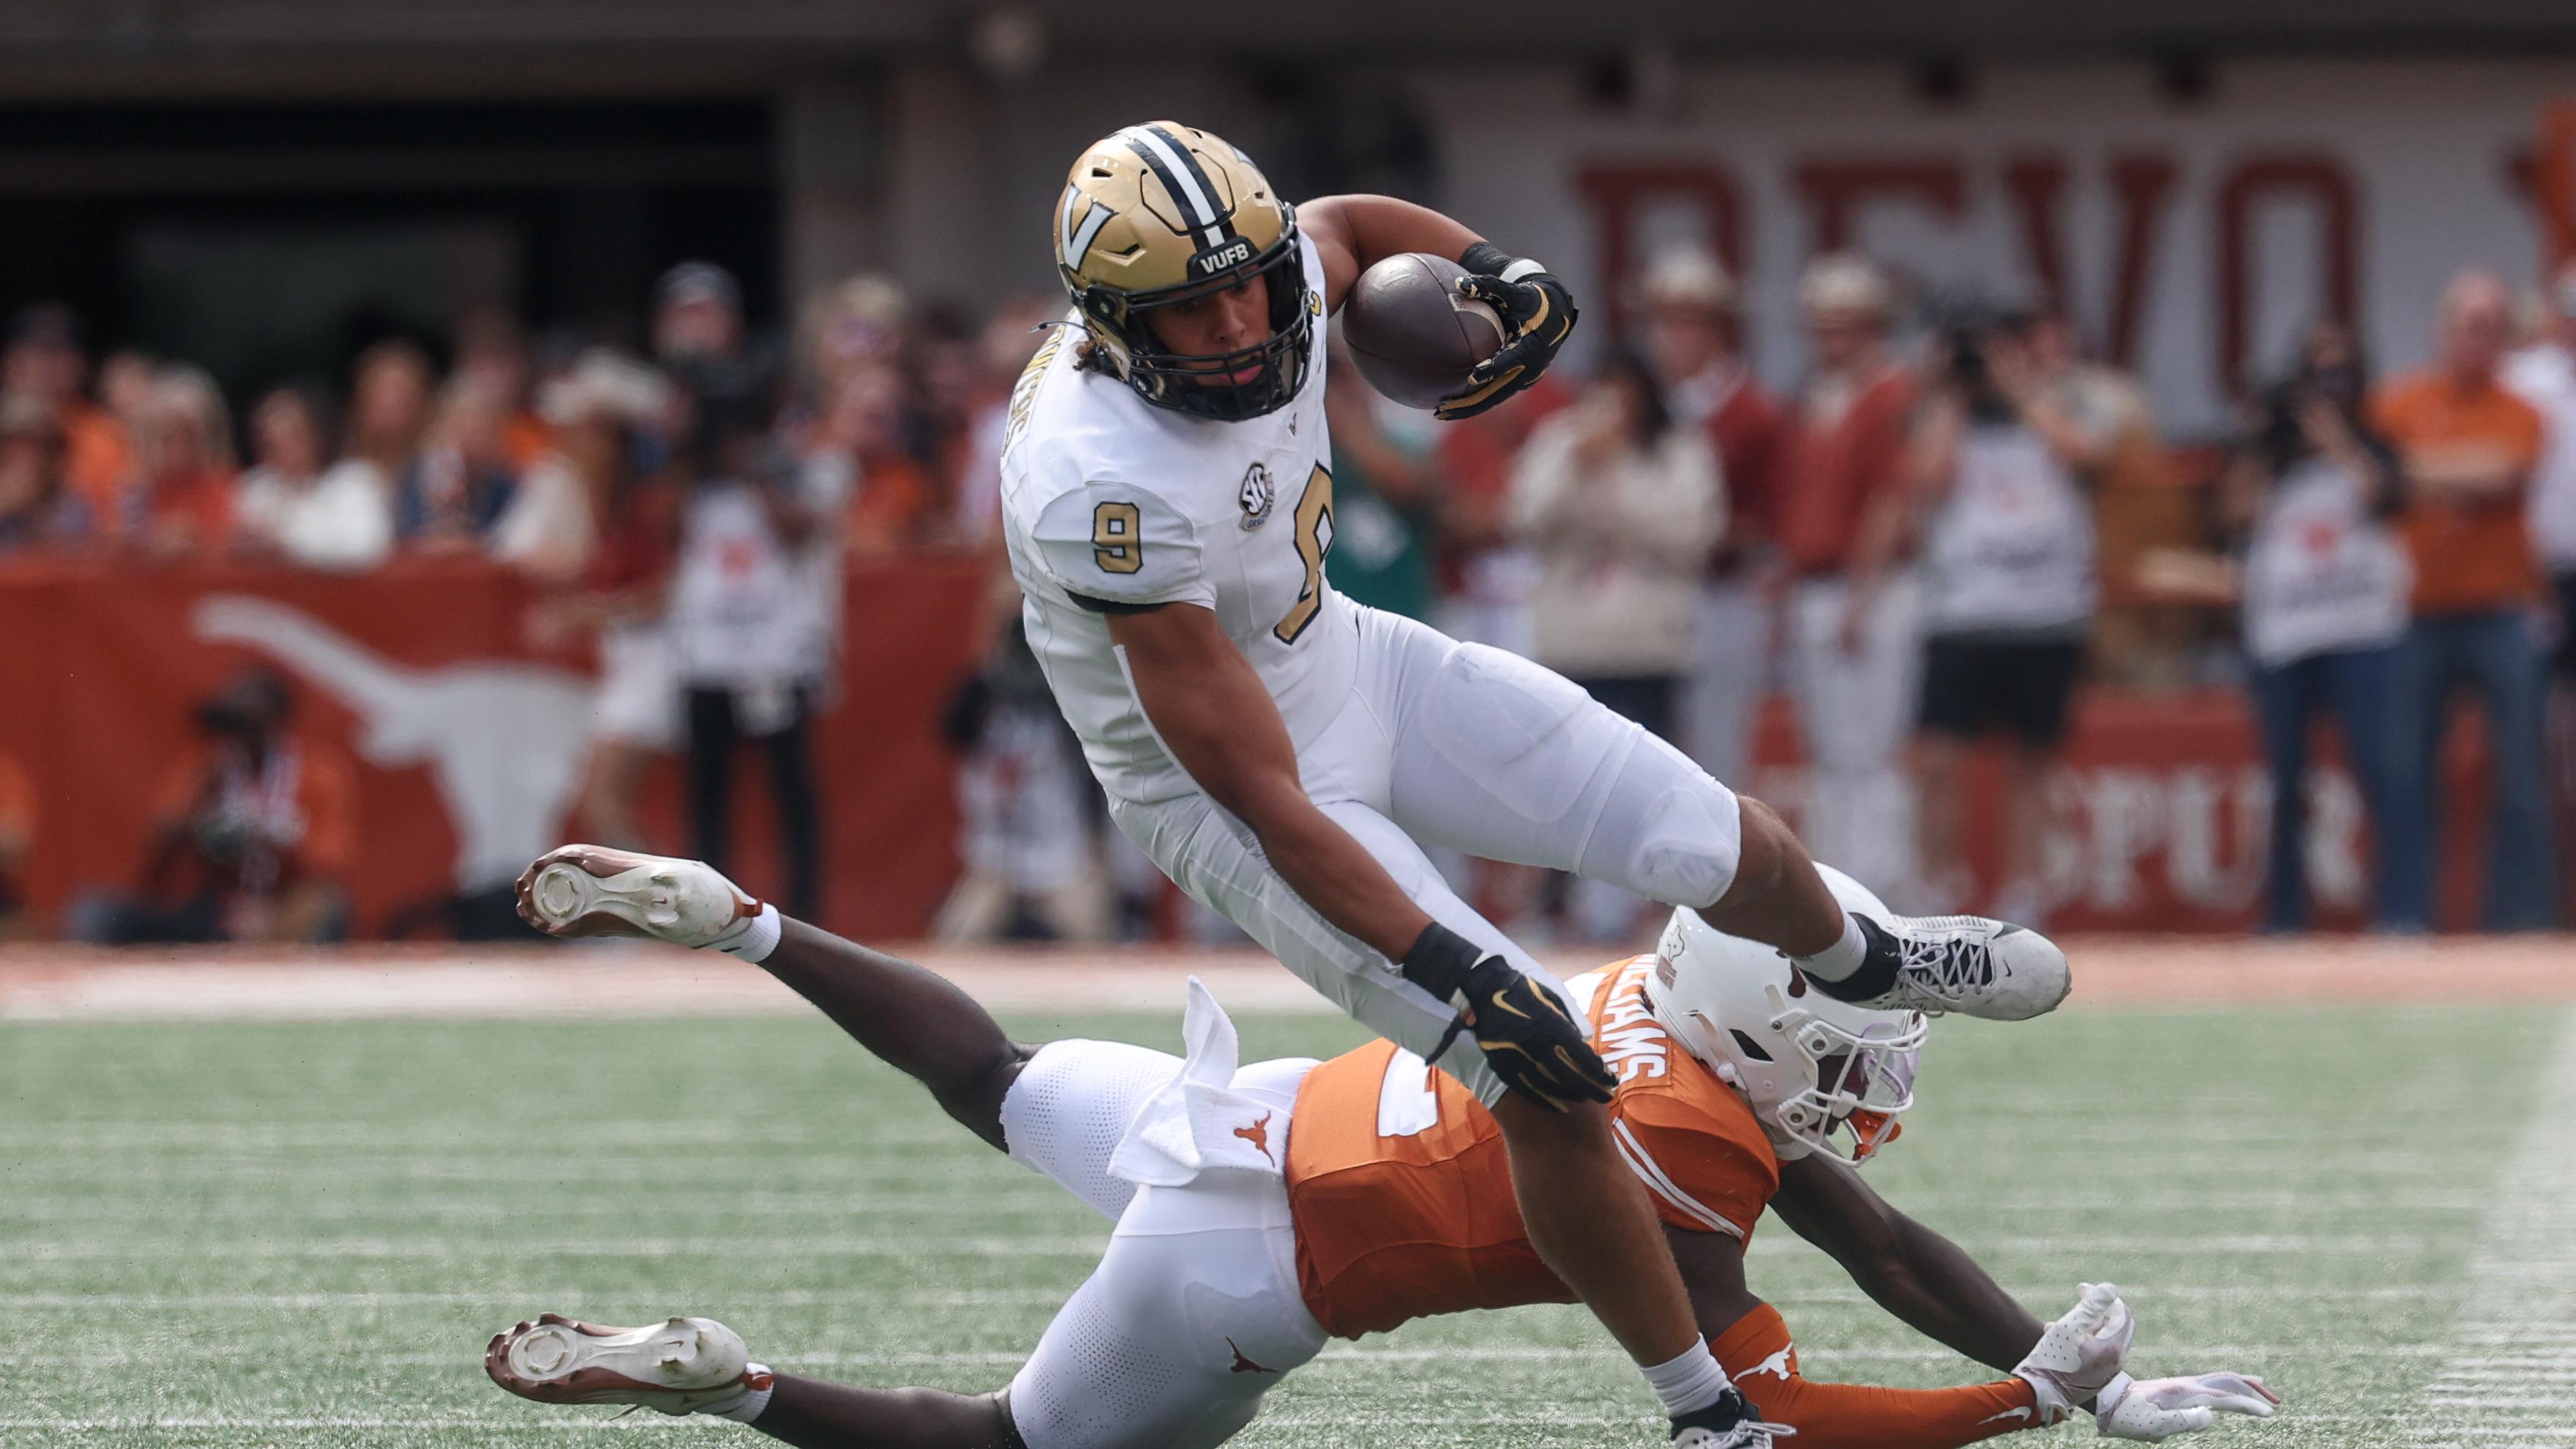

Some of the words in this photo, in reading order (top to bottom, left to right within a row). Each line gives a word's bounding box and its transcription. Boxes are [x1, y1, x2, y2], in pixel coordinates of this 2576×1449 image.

[1061, 183, 1119, 275] V
[1199, 243, 1250, 274] VUFB
[1091, 501, 1143, 574] 9
[1273, 459, 1334, 646] 9
